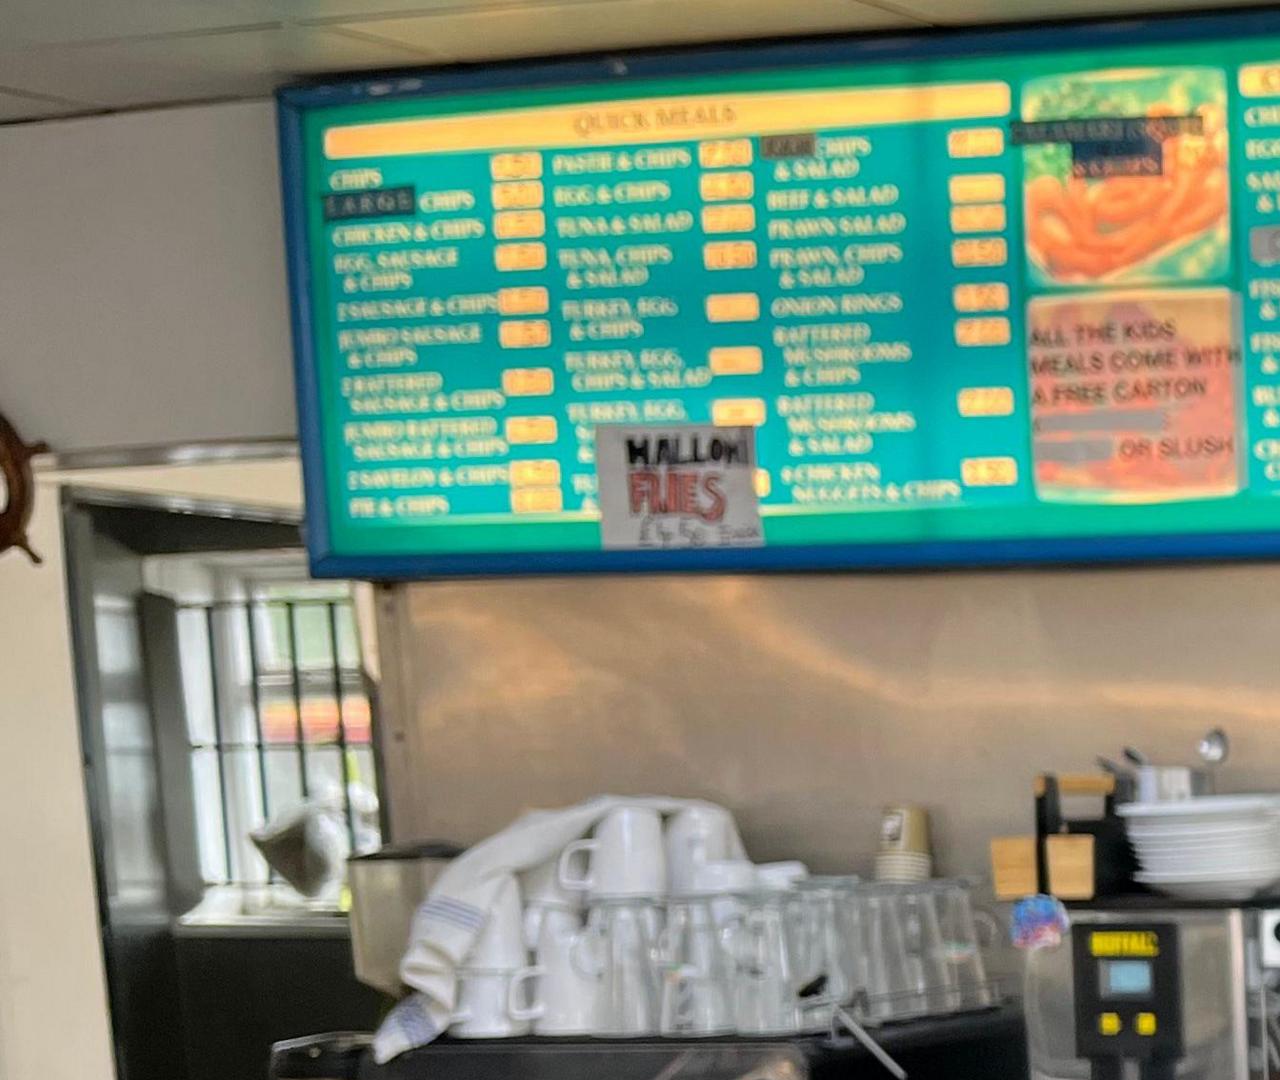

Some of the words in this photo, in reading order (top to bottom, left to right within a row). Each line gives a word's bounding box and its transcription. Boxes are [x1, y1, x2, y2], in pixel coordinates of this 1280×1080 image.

[1125, 318, 1177, 341] KIDS
[1110, 349, 1174, 371] COME
[1114, 378, 1207, 402] CARTON
